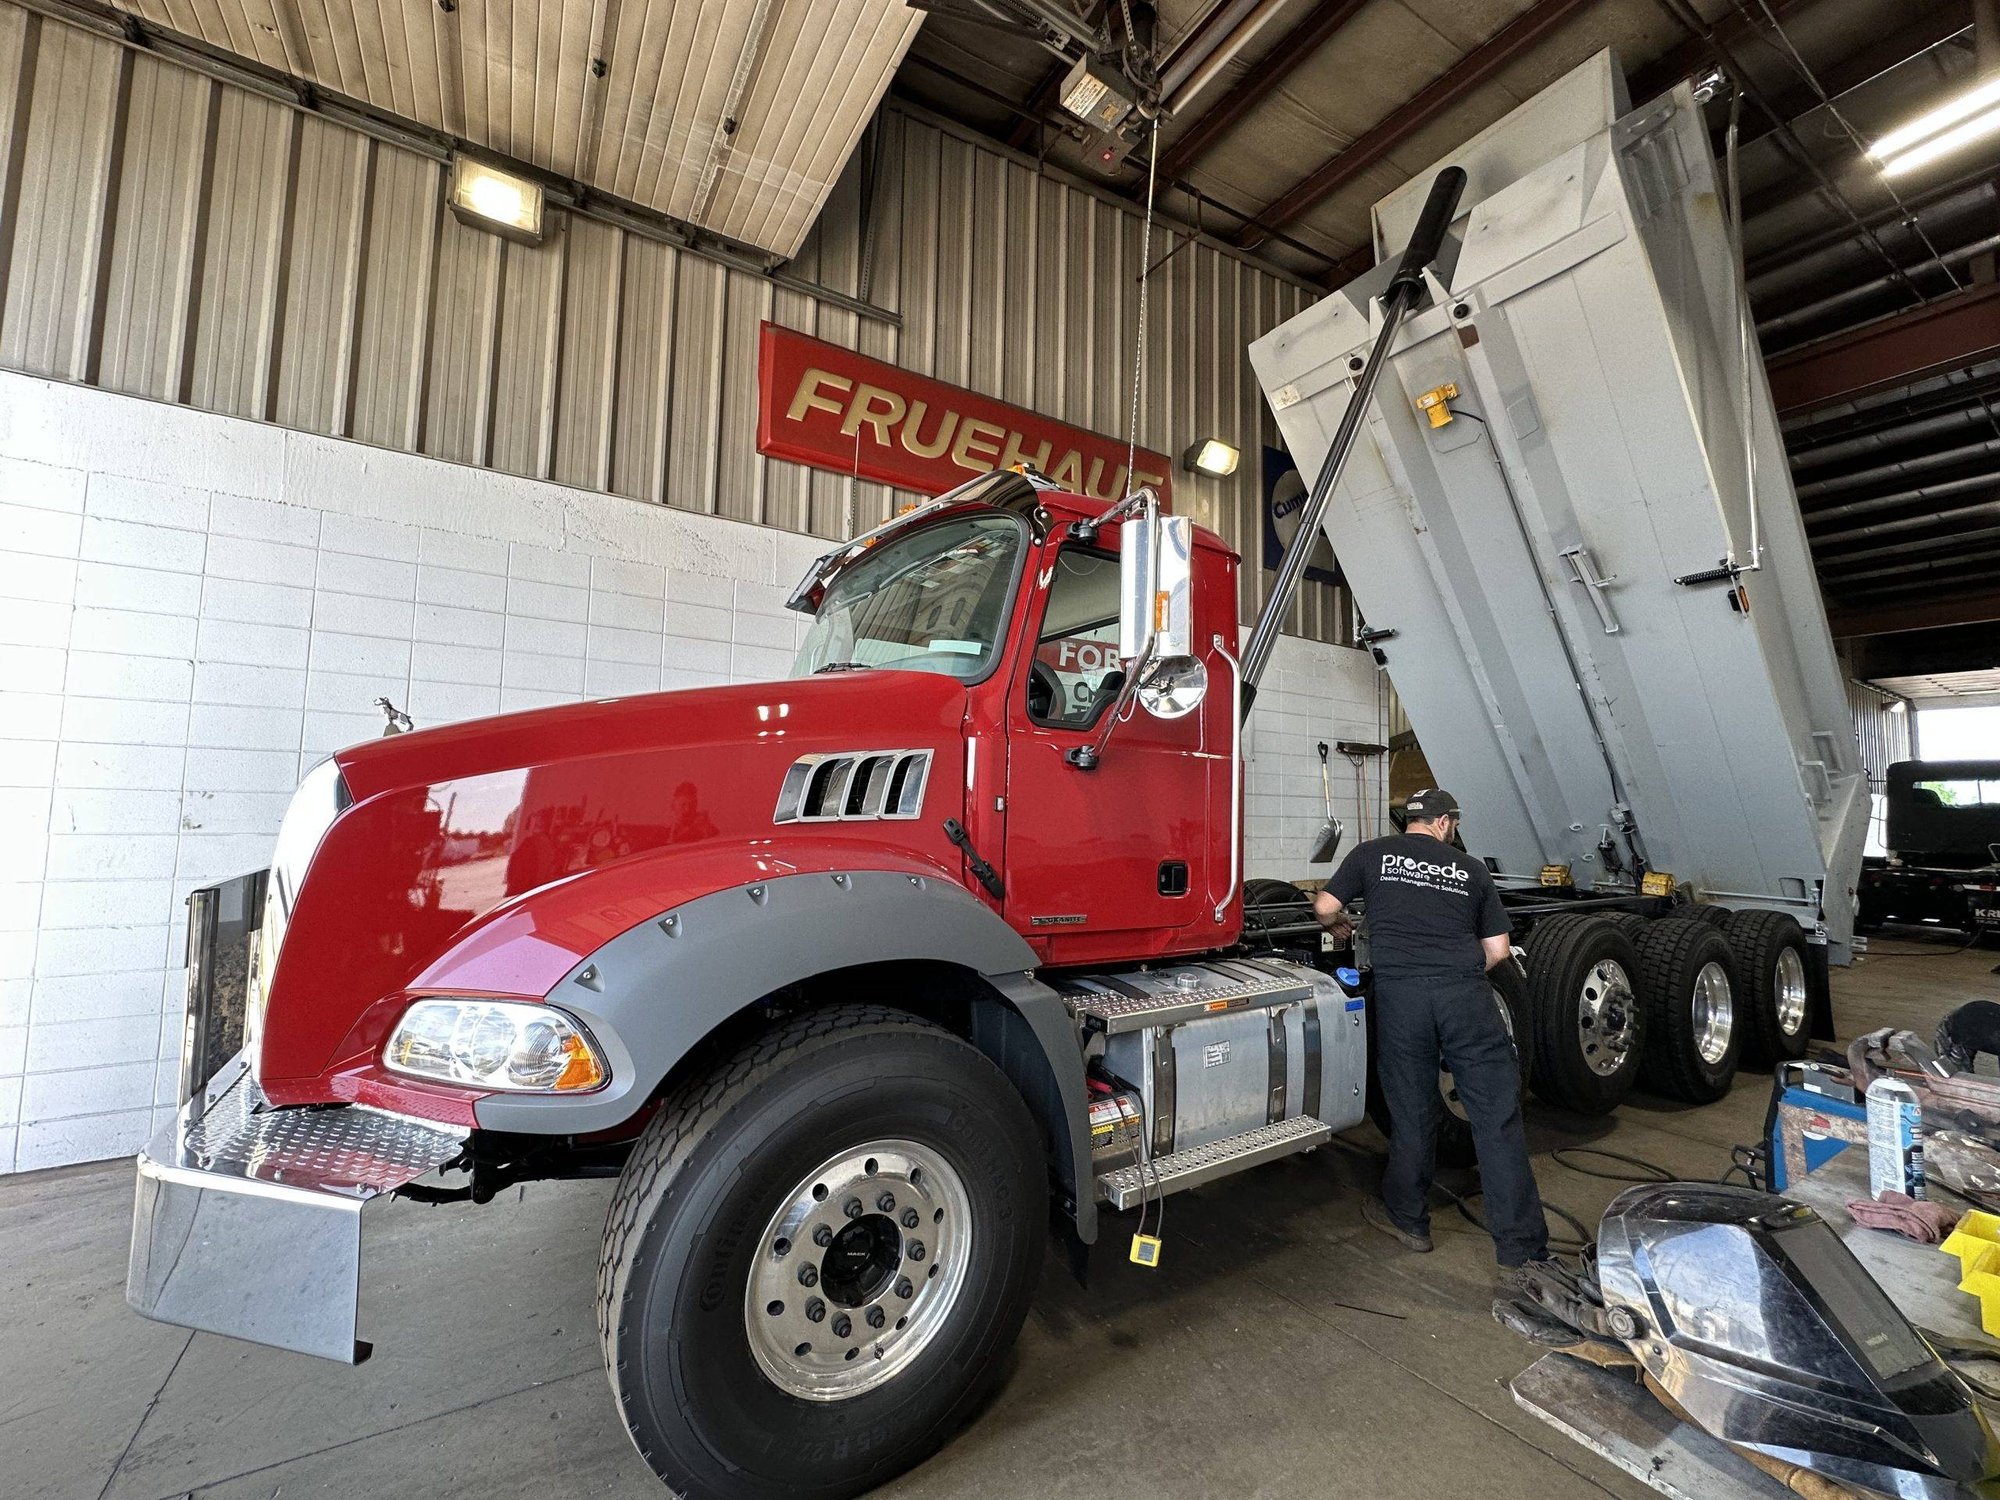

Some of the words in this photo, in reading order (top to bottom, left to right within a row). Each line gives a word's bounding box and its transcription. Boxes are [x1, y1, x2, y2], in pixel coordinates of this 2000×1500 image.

[1381, 854, 1469, 882] procede
[1387, 866, 1430, 881] software
[1400, 876, 1440, 890] Management
[1441, 885, 1469, 896] Solutions
